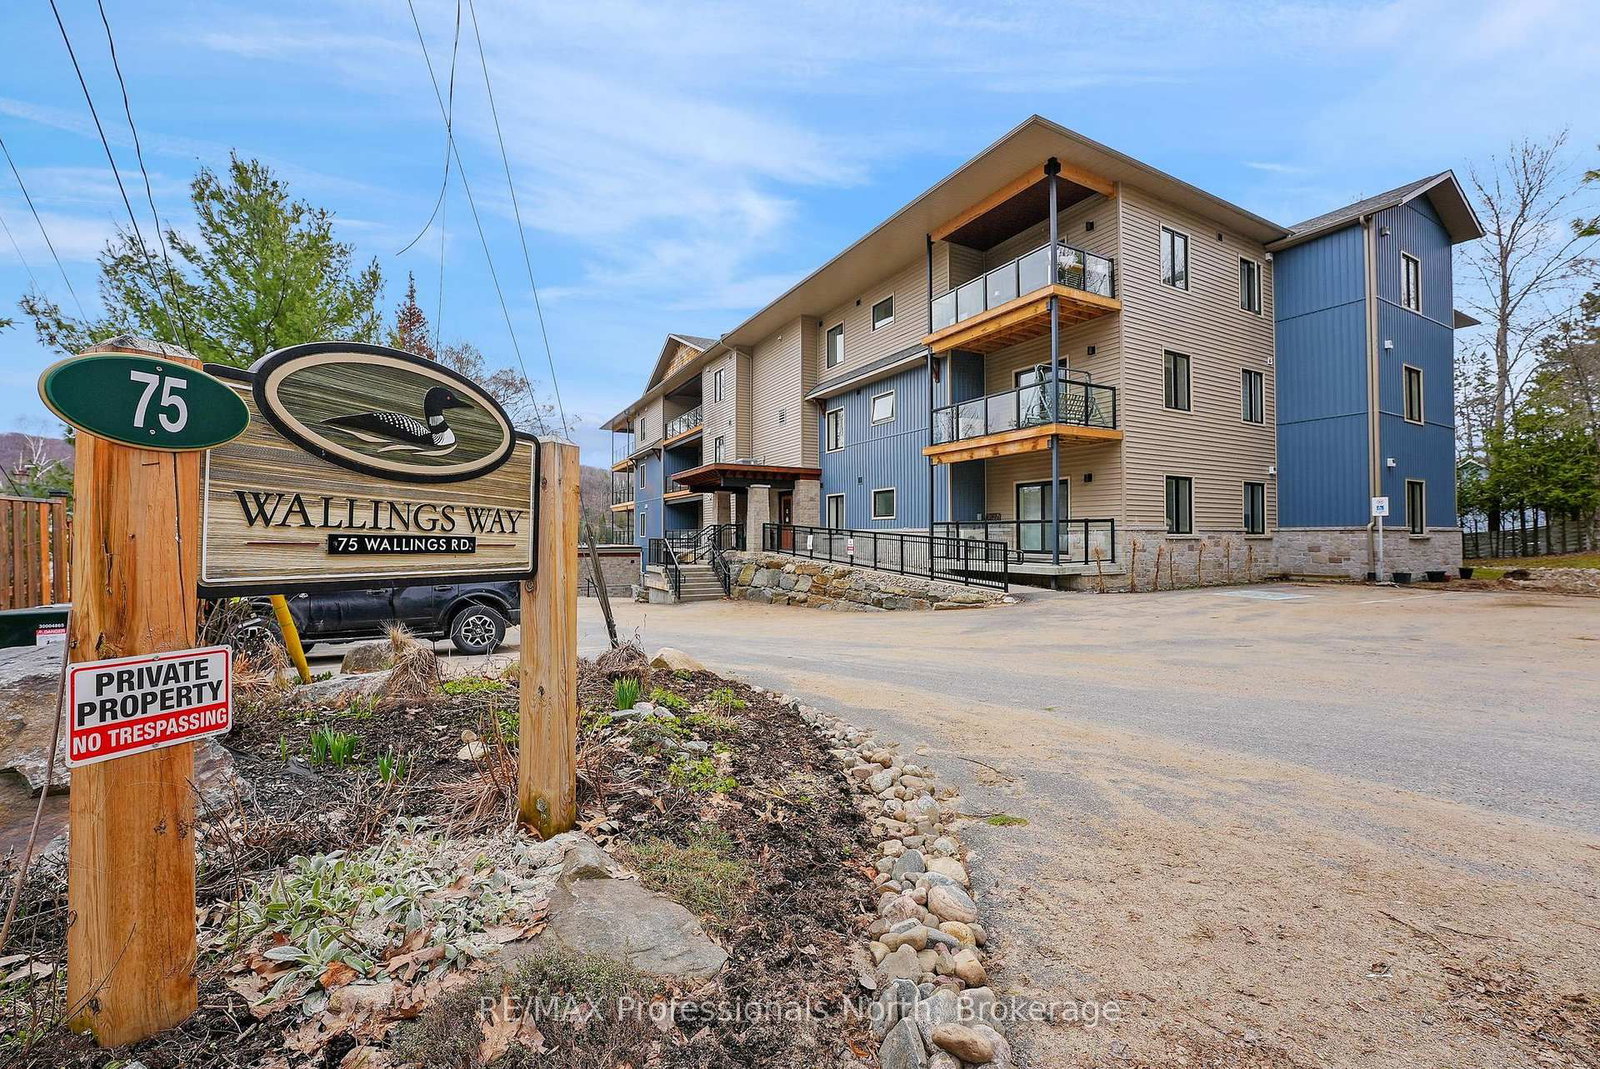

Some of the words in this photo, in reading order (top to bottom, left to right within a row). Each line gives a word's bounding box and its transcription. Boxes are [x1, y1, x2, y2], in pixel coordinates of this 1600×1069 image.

[130, 370, 188, 433] 75
[234, 490, 457, 533] WALLINGS
[464, 506, 525, 535] WAY
[337, 536, 358, 552] 75
[364, 537, 447, 552] WALLINGS
[451, 538, 474, 552] RD.
[95, 659, 208, 697] PRIVATE
[77, 681, 223, 727] PROPERTY
[72, 734, 102, 755] NO
[107, 708, 227, 747] TRESPASSING
